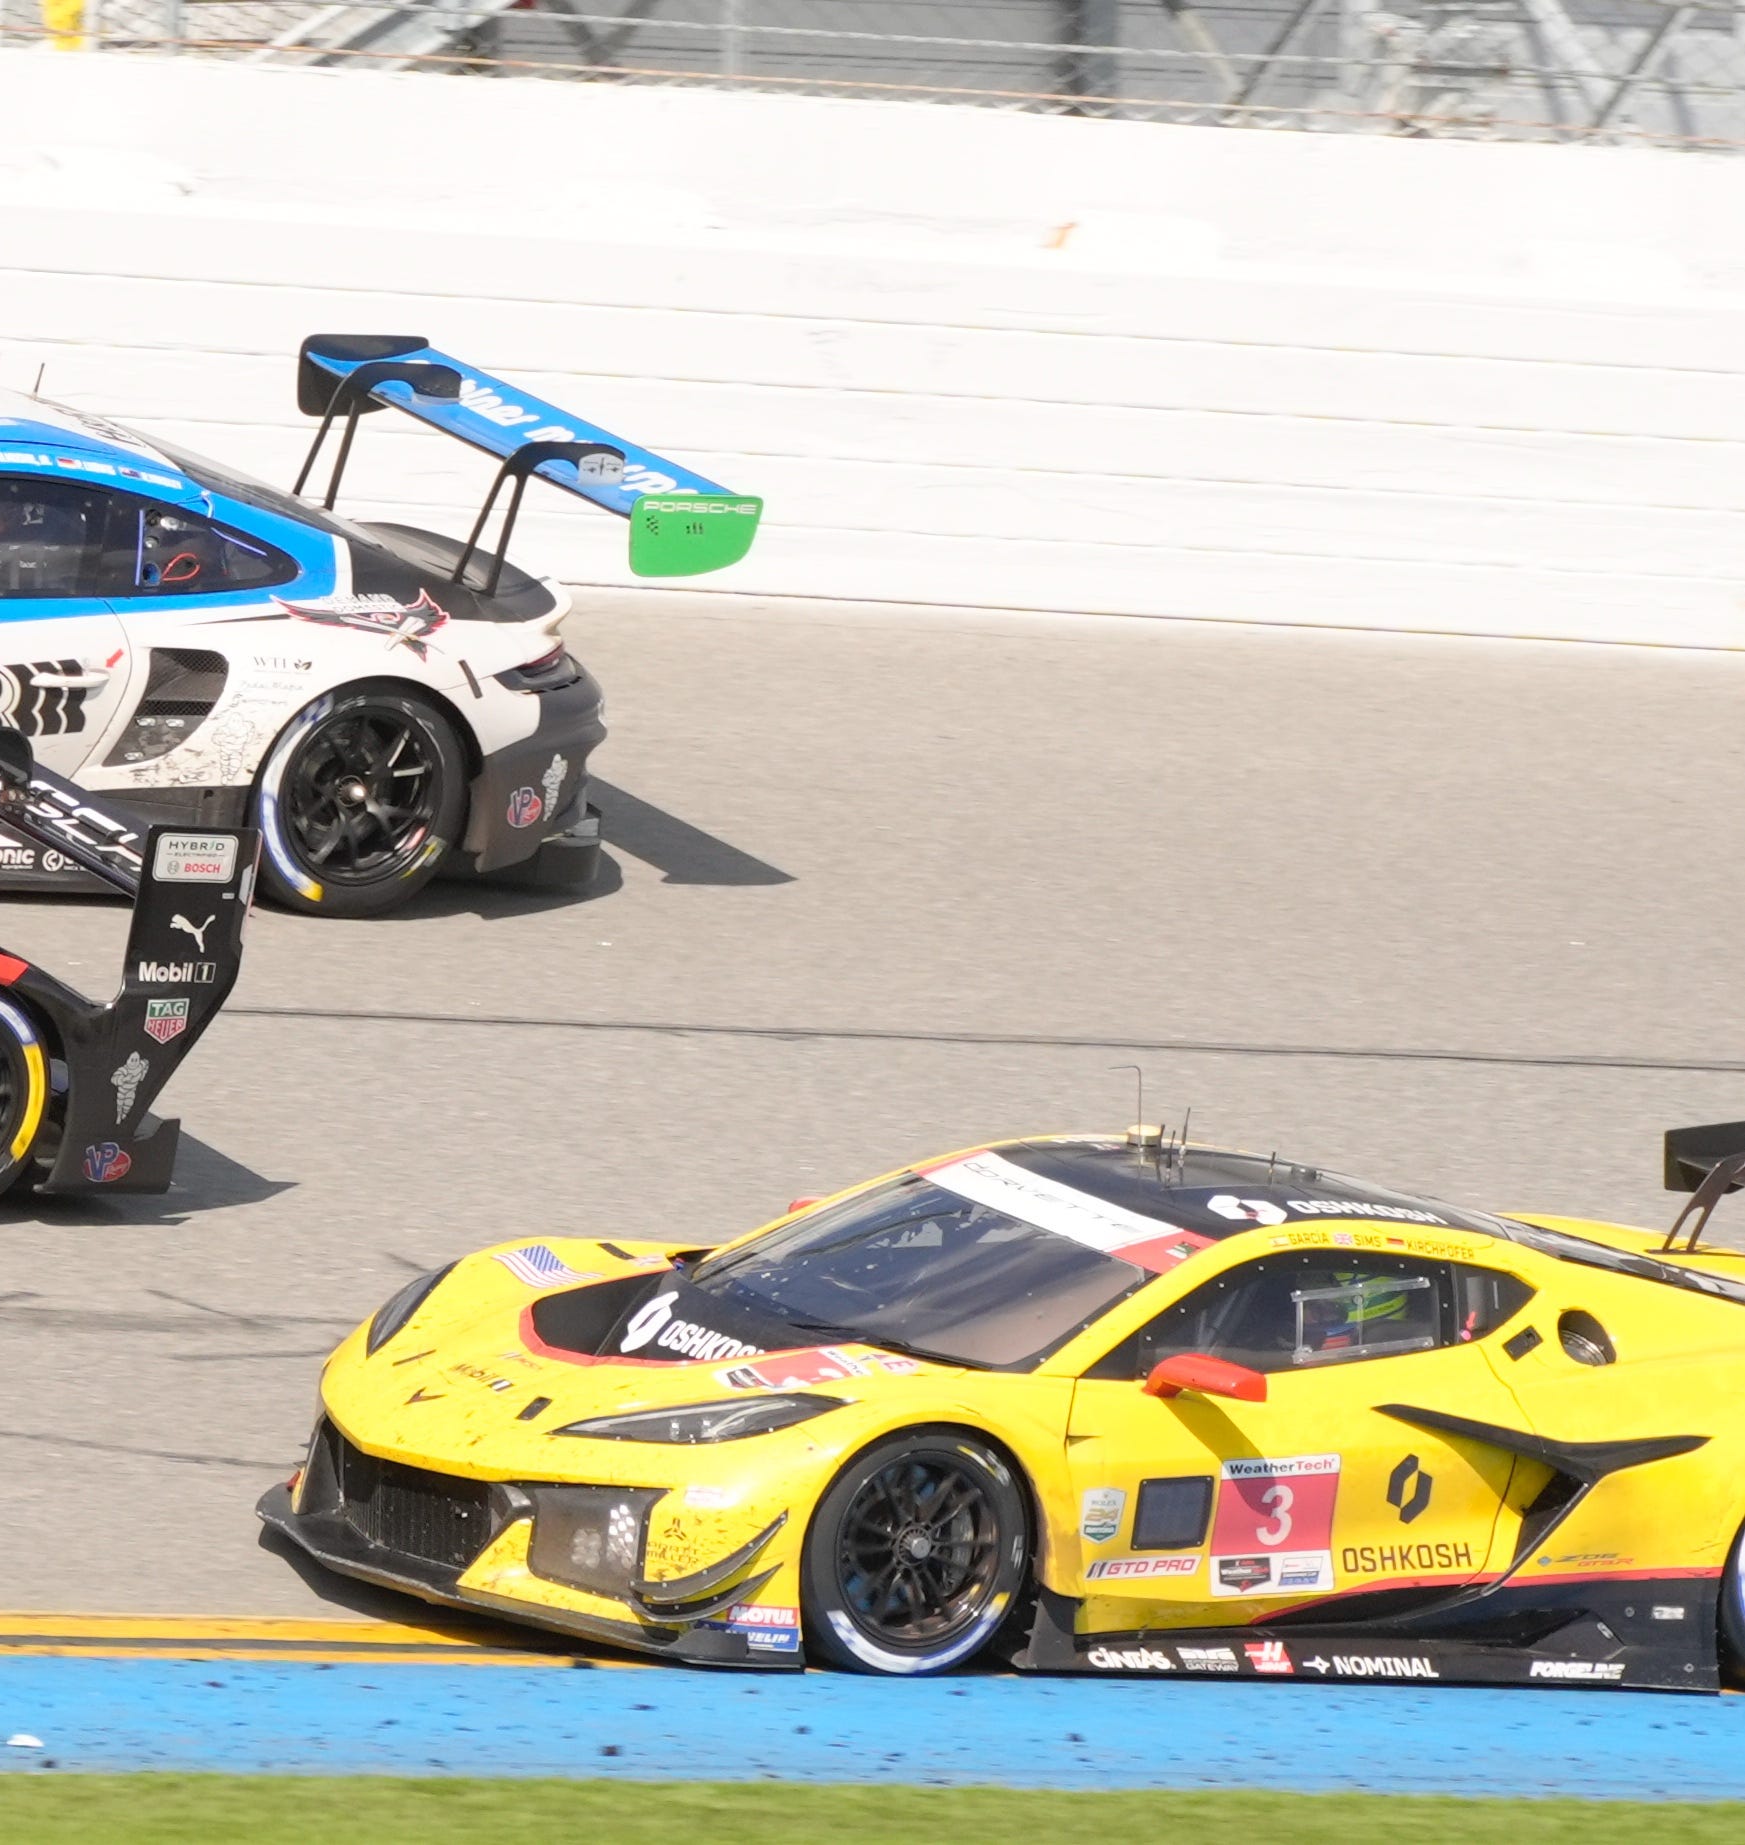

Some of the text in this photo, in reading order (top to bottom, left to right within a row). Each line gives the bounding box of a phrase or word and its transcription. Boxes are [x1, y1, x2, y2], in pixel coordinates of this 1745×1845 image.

[643, 500, 758, 515] PORSCHE
[169, 840, 225, 851] HYBRID
[184, 863, 221, 874] BOSCH
[138, 961, 194, 982] Mobil
[151, 1002, 185, 1016] TAG
[148, 1018, 185, 1040] HEUER
[86, 1141, 120, 1181] VP
[1285, 1199, 1449, 1226] OSHKOSH
[1353, 1234, 1382, 1248] SIMS
[1407, 1239, 1475, 1260] KIRCHHOFER
[657, 1320, 765, 1361] OSHKO
[1229, 1458, 1334, 1475] WeatherTech
[1085, 1507, 1119, 1522] 24
[1256, 1485, 1295, 1546] 3
[1106, 1558, 1197, 1576] GTD PRO
[1342, 1542, 1473, 1573] OSHKOSH
[728, 1605, 796, 1624] MOTUL
[1332, 1655, 1440, 1679] NOMINAL
[1529, 1660, 1626, 1680] FORGELINE
